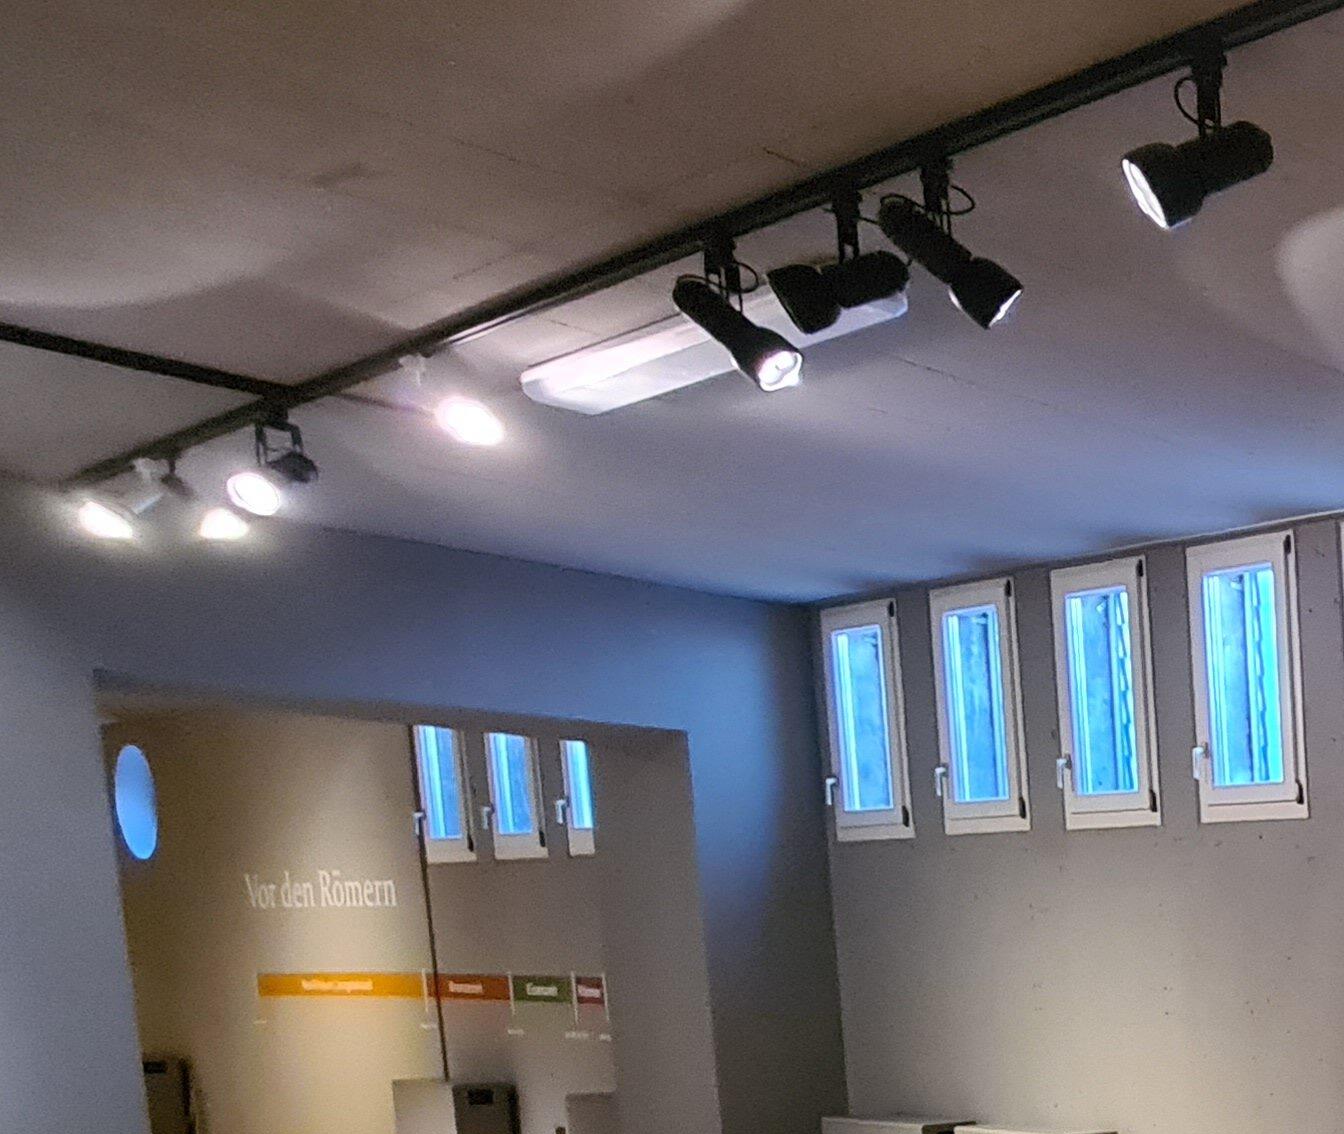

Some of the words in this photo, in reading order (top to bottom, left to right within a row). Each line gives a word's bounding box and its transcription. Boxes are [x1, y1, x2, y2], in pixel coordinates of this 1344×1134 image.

[244, 872, 277, 910] Vor
[281, 870, 316, 908] den
[319, 869, 398, 908] Römern
